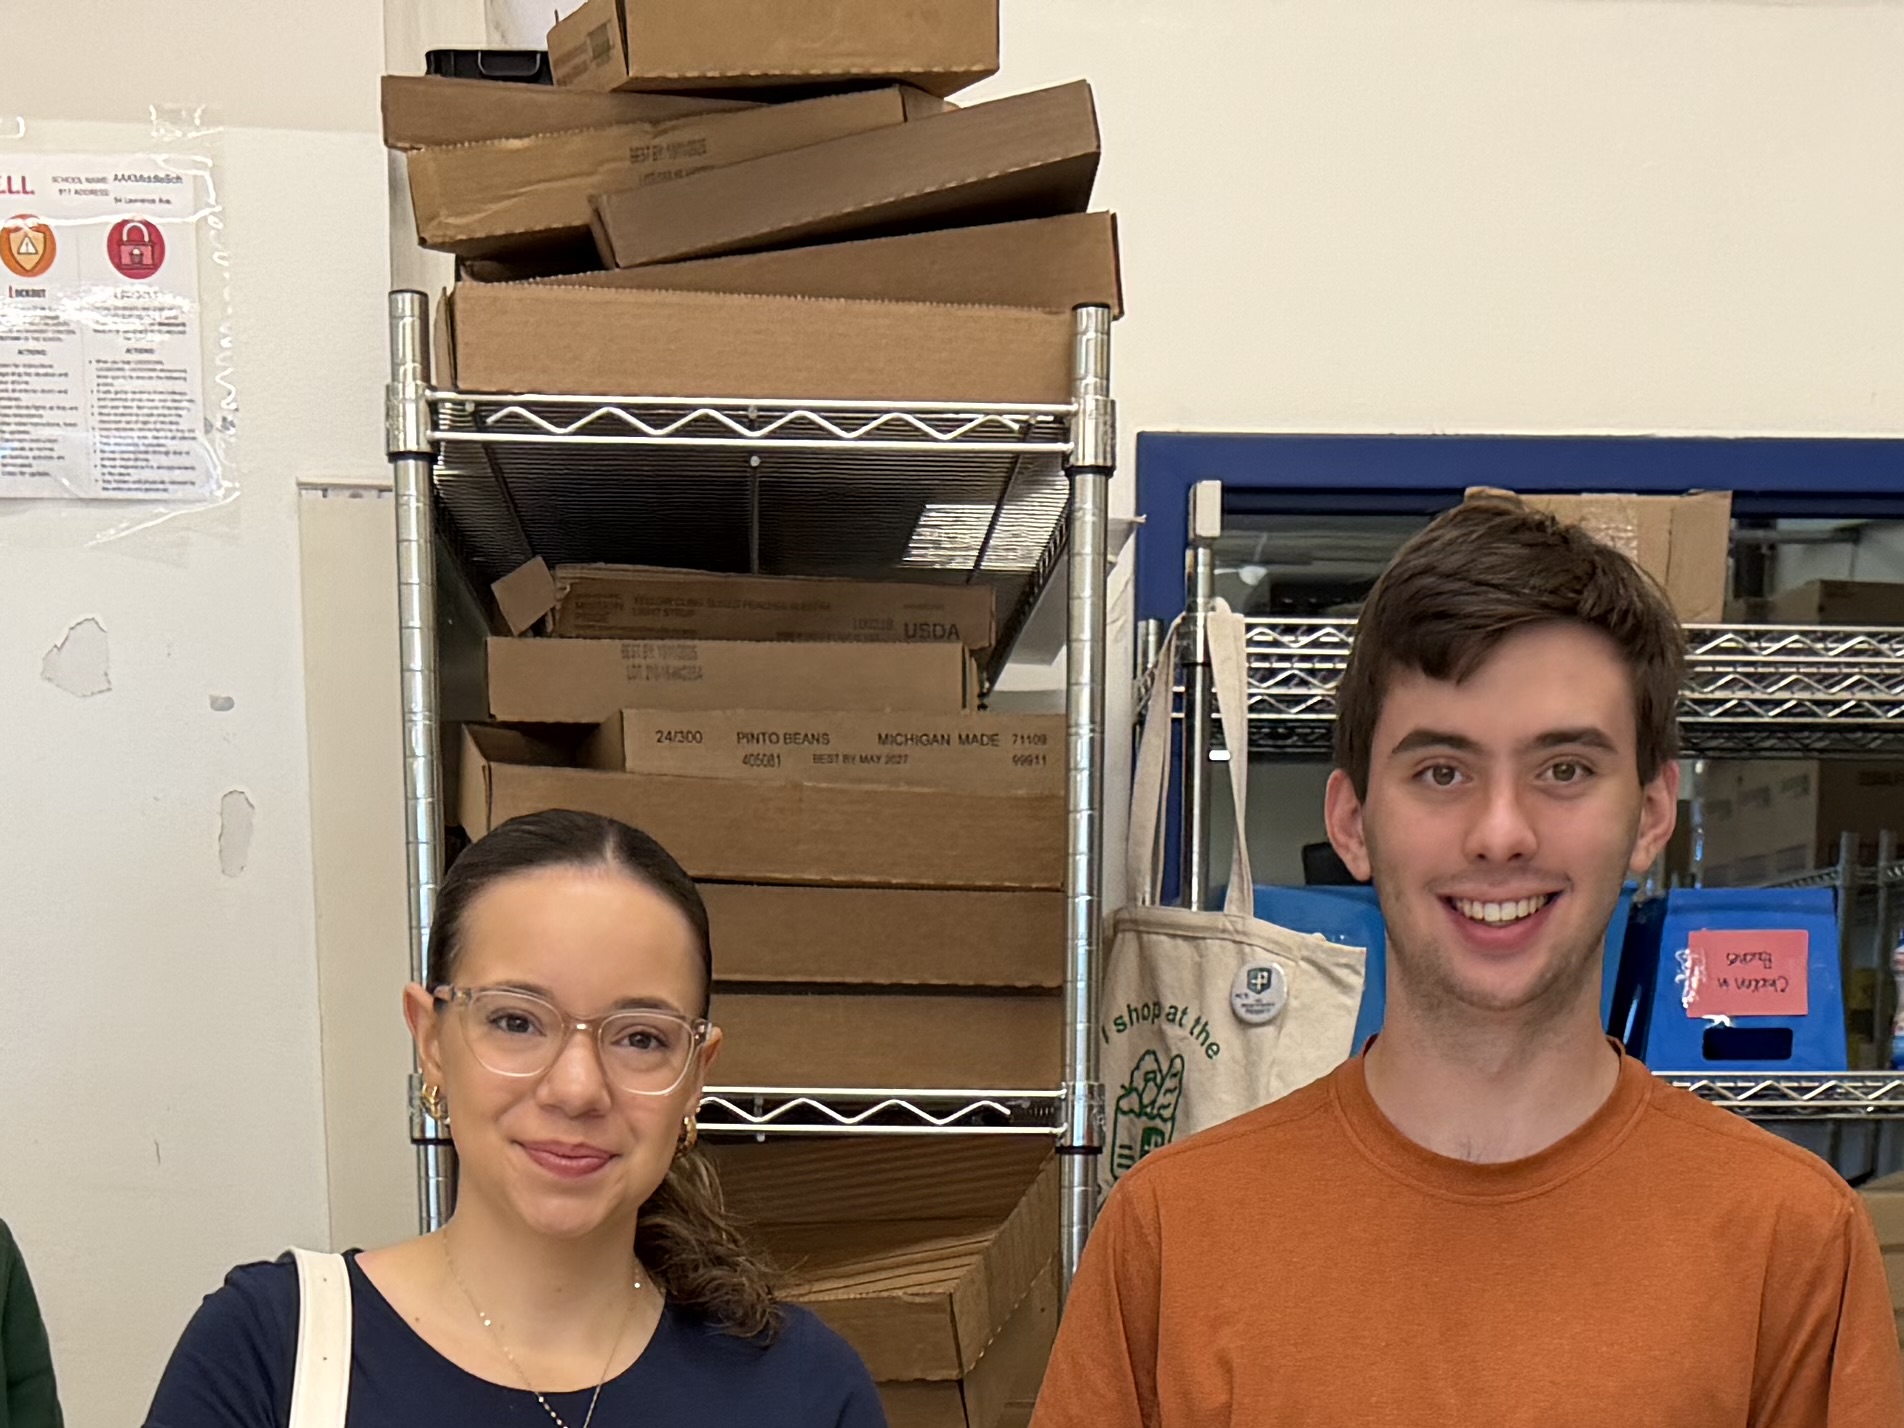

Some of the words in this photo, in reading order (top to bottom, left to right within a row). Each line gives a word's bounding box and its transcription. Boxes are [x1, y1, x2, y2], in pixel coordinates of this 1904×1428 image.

[903, 622, 961, 641] USDA
[736, 731, 780, 745] PINTO
[783, 731, 831, 745] BEANS
[877, 732, 951, 746] MICHIGAN
[958, 732, 1001, 747] MADE
[812, 753, 839, 764] BEST
[858, 754, 882, 765] MAY
[1113, 1002, 1161, 1033] shop
[1166, 1004, 1188, 1027] at
[1189, 1016, 1221, 1060] the
